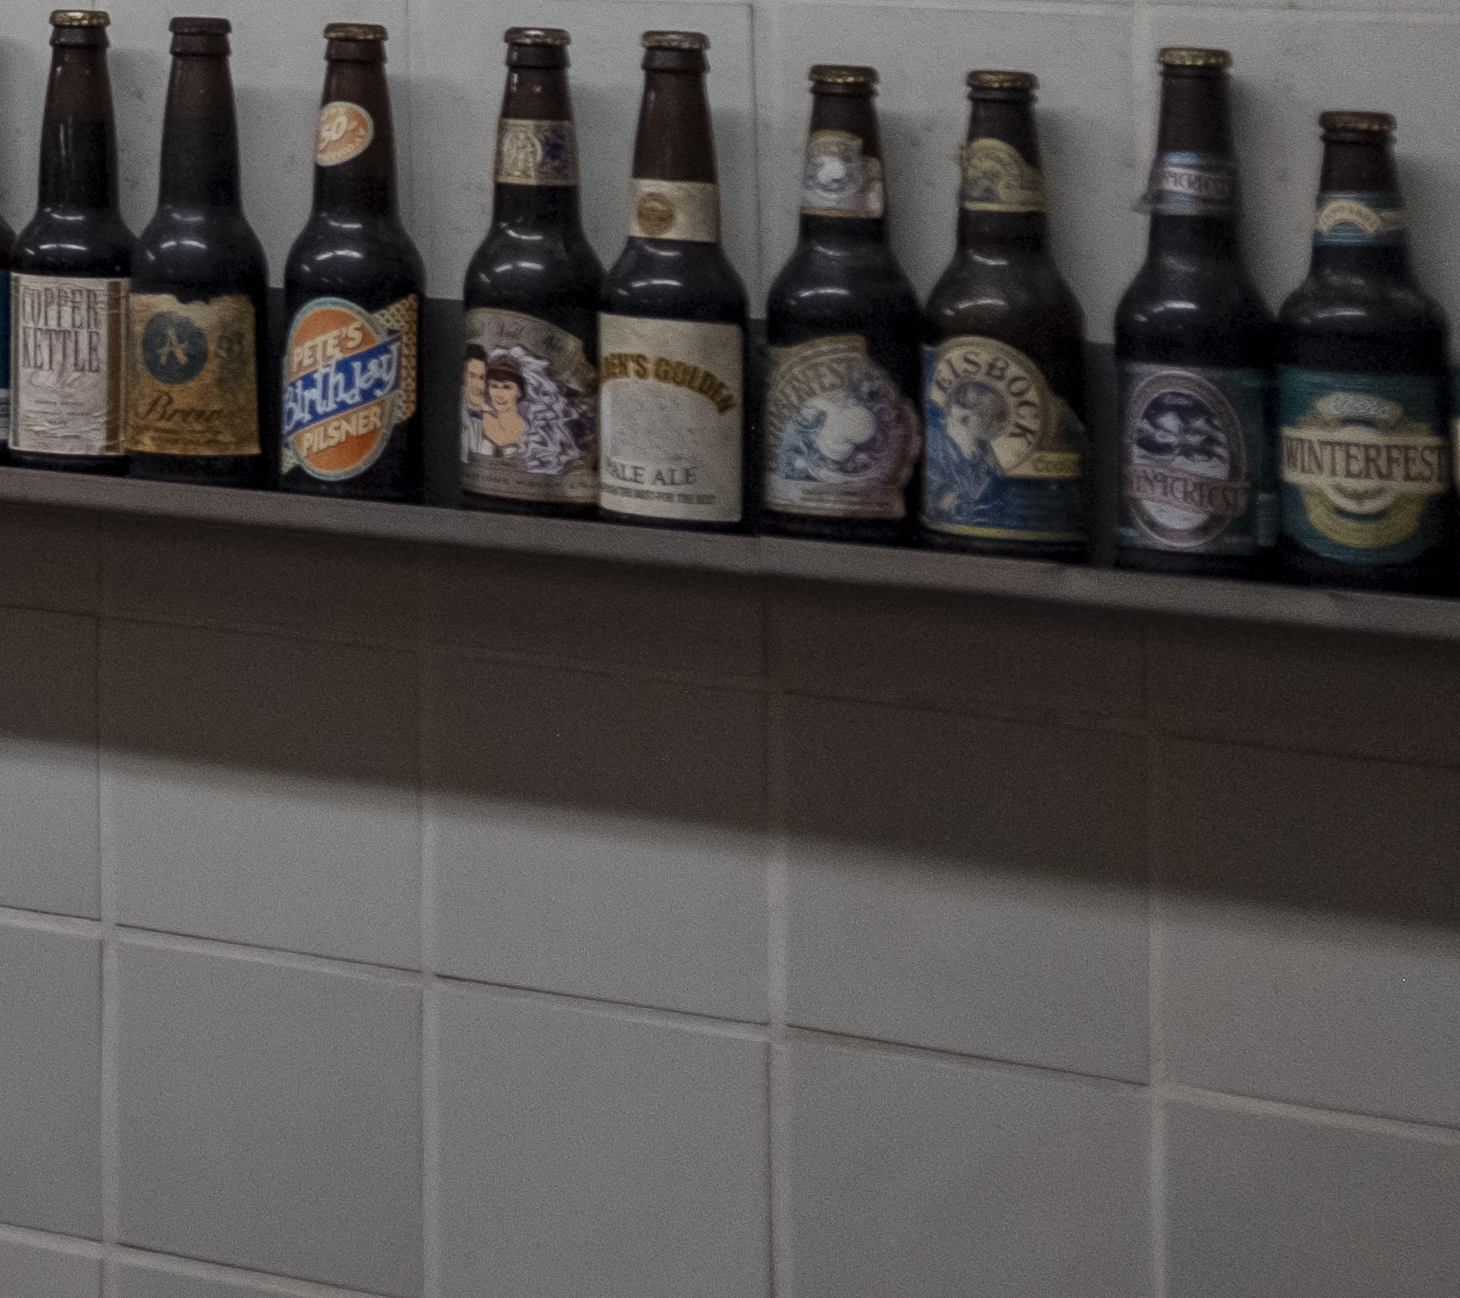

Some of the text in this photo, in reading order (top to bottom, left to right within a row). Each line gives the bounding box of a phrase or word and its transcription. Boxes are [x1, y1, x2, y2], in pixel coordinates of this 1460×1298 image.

[21, 287, 100, 330] COPPER
[20, 328, 102, 374] KETTLE
[291, 320, 365, 375] PETE'S
[137, 388, 225, 425] Brew
[281, 340, 402, 434] Birthday
[301, 404, 384, 458] PILSNER
[650, 465, 699, 488] ALE
[1282, 435, 1448, 487] WINTERFEST
